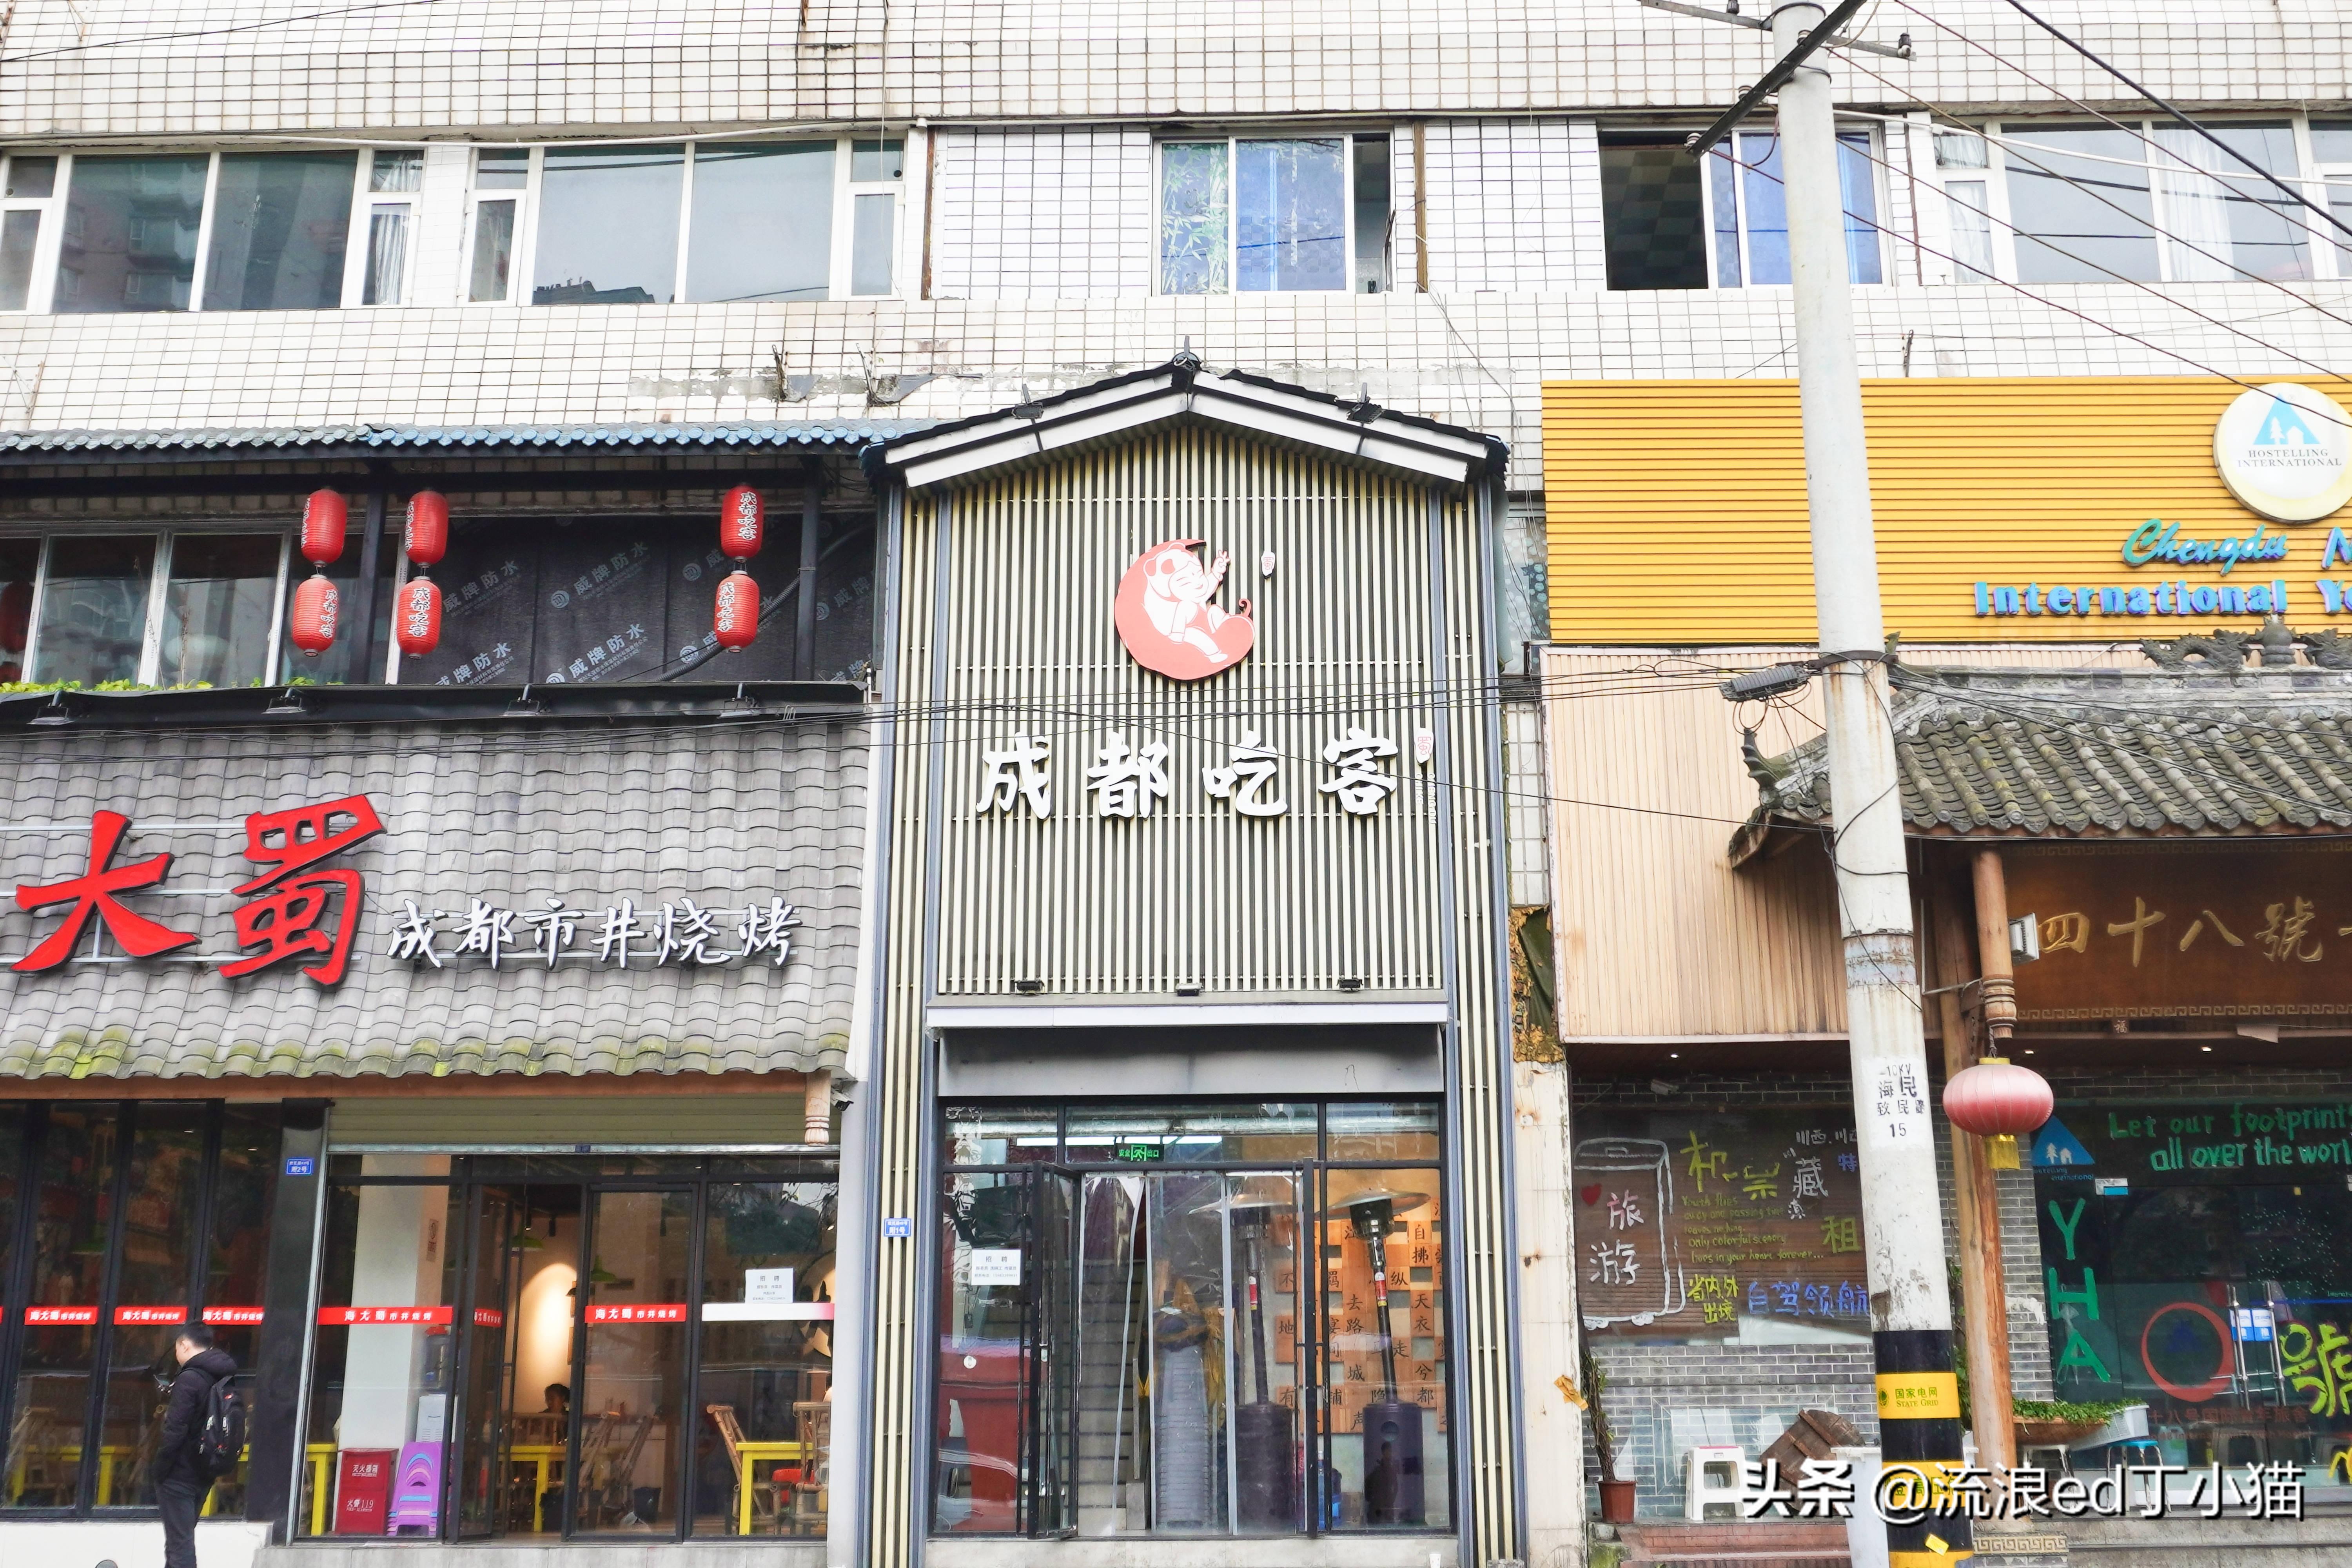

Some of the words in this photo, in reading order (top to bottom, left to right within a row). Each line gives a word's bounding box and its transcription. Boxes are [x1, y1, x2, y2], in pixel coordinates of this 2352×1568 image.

[2238, 458, 2342, 468] INTERNATIONAL
[2249, 448, 2328, 458] HOSTELLING
[2122, 518, 2288, 576] Chengdu
[408, 587, 430, 637] 成都吃客
[1974, 579, 2287, 615] International
[569, 623, 645, 678] 威牌防水
[976, 728, 1399, 819] 成都吃客
[387, 897, 801, 969] 成都市井烧烤
[2038, 896, 2352, 967] 四十八號
[1889, 1123, 1907, 1138] 15
[2109, 1112, 2156, 1140] Let
[2169, 1115, 2215, 1134] our
[1680, 1130, 1780, 1200] 机票
[2150, 1136, 2184, 1171] all
[2192, 1143, 2248, 1167] over
[2254, 1136, 2293, 1166] the
[1589, 1189, 1644, 1285] 旅游
[1821, 1216, 1862, 1254] 租
[1748, 1279, 1870, 1318] 自驾领航
[1895, 1387, 1938, 1399] 国家电网
